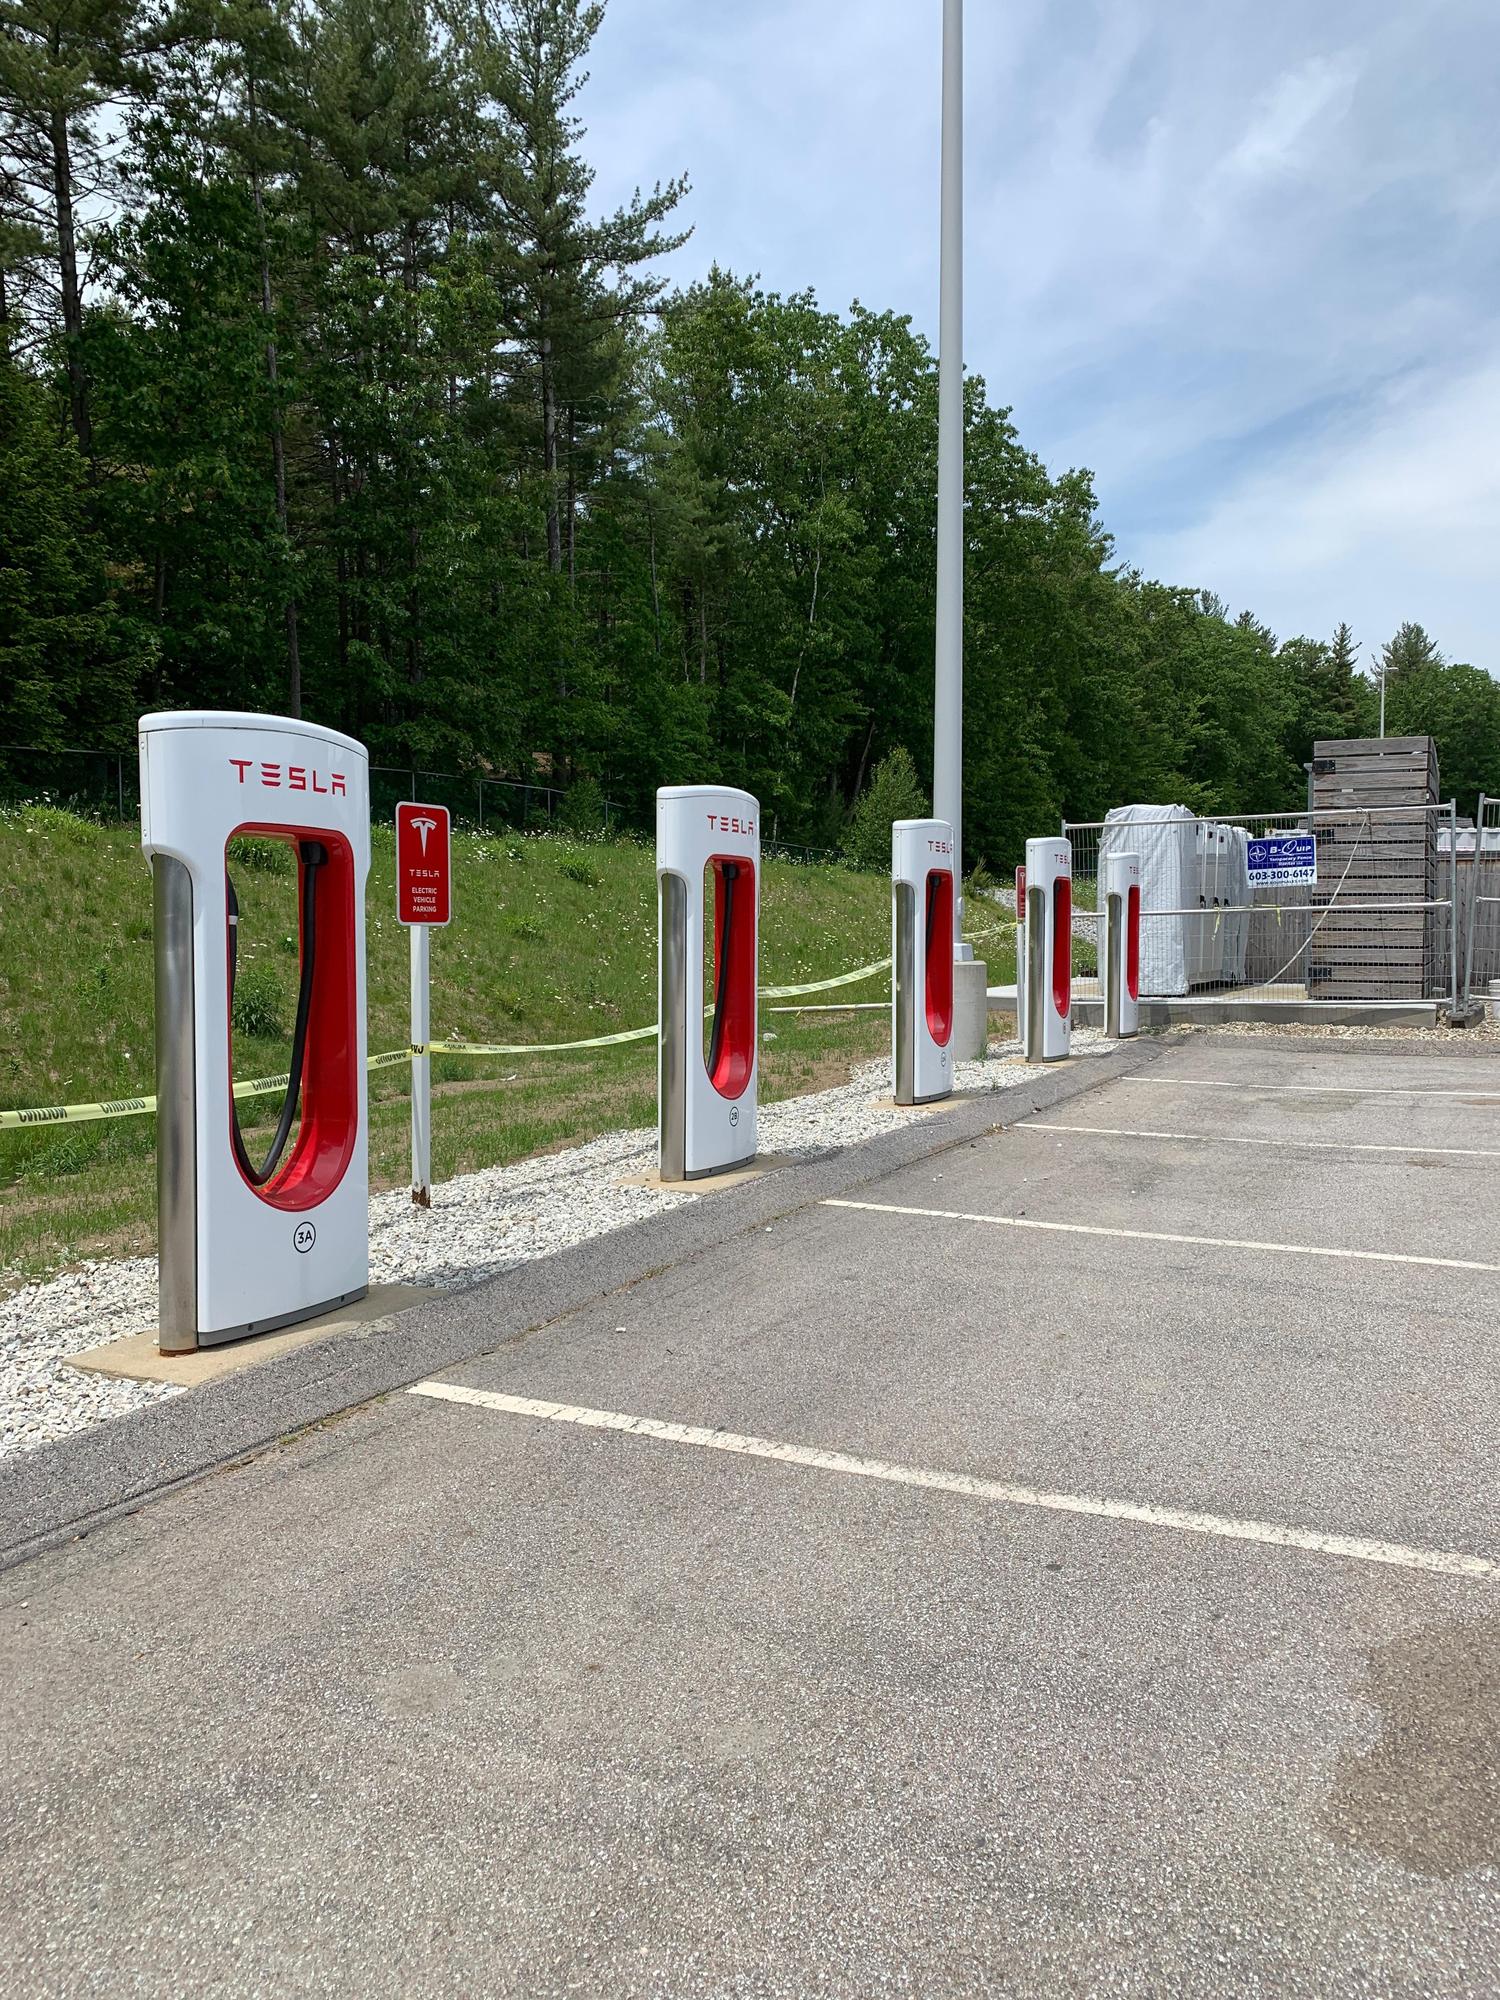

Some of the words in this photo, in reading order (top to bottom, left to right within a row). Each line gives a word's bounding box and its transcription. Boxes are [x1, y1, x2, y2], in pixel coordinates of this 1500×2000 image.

[228, 759, 346, 797] TESLA
[706, 814, 754, 836] TESLA
[409, 868, 440, 878] TESLA
[1248, 869, 1315, 881] 603-300-6147
[411, 887, 438, 895] ELECTRIC
[413, 896, 436, 904] VEHICLE
[412, 905, 437, 913] PARKING
[297, 1229, 313, 1244] 3A
